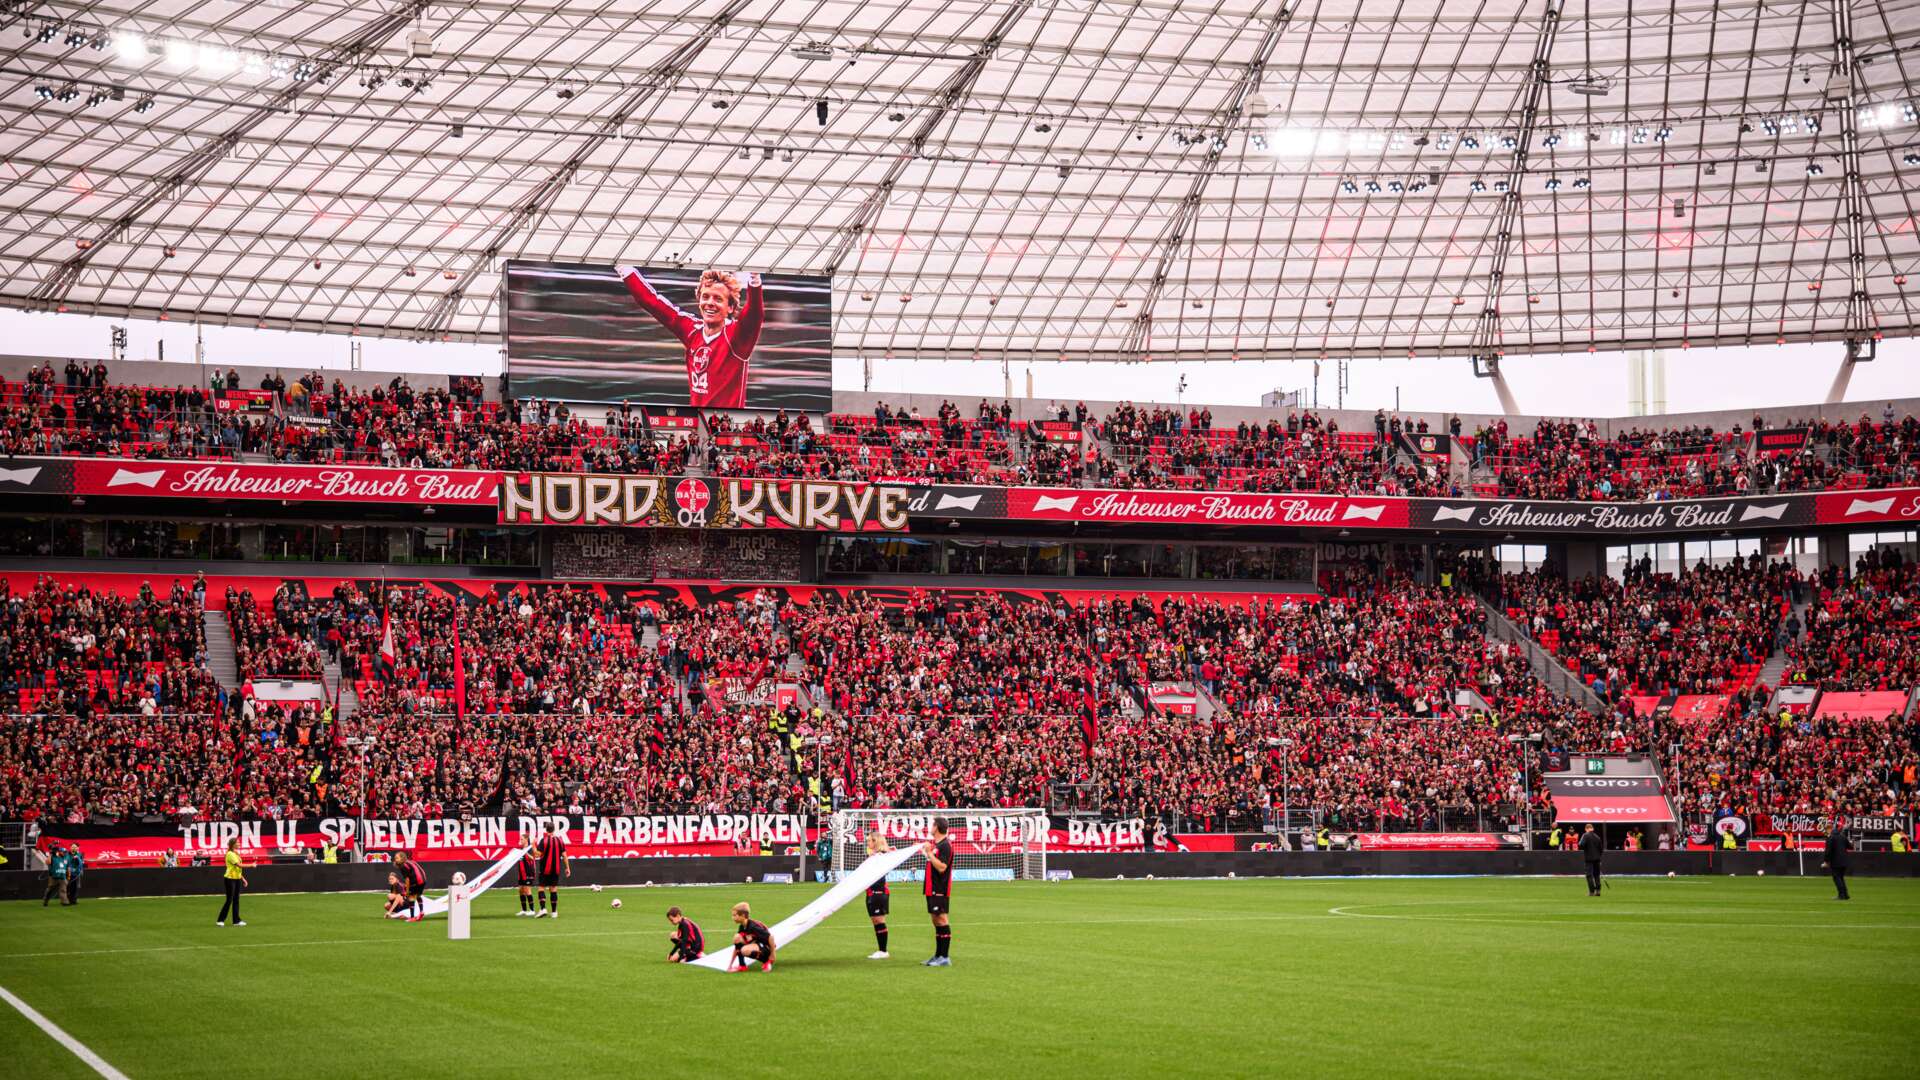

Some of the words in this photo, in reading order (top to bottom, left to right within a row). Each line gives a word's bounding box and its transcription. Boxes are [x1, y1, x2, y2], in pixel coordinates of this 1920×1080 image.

[170, 466, 409, 496] Anheuser-Busch
[414, 474, 485, 500] Bud
[505, 476, 659, 525] NORD
[730, 479, 909, 532] KURVE
[1082, 493, 1276, 521] Anheuser-Busch
[1280, 499, 1339, 523] Bud
[1479, 503, 1666, 529] Anheuser-Busch
[1671, 503, 1735, 528] Bud
[678, 508, 707, 528] 04
[519, 816, 570, 845] DER
[583, 814, 808, 845] FARBENFABRIKEN
[1068, 818, 1145, 846] BAYER
